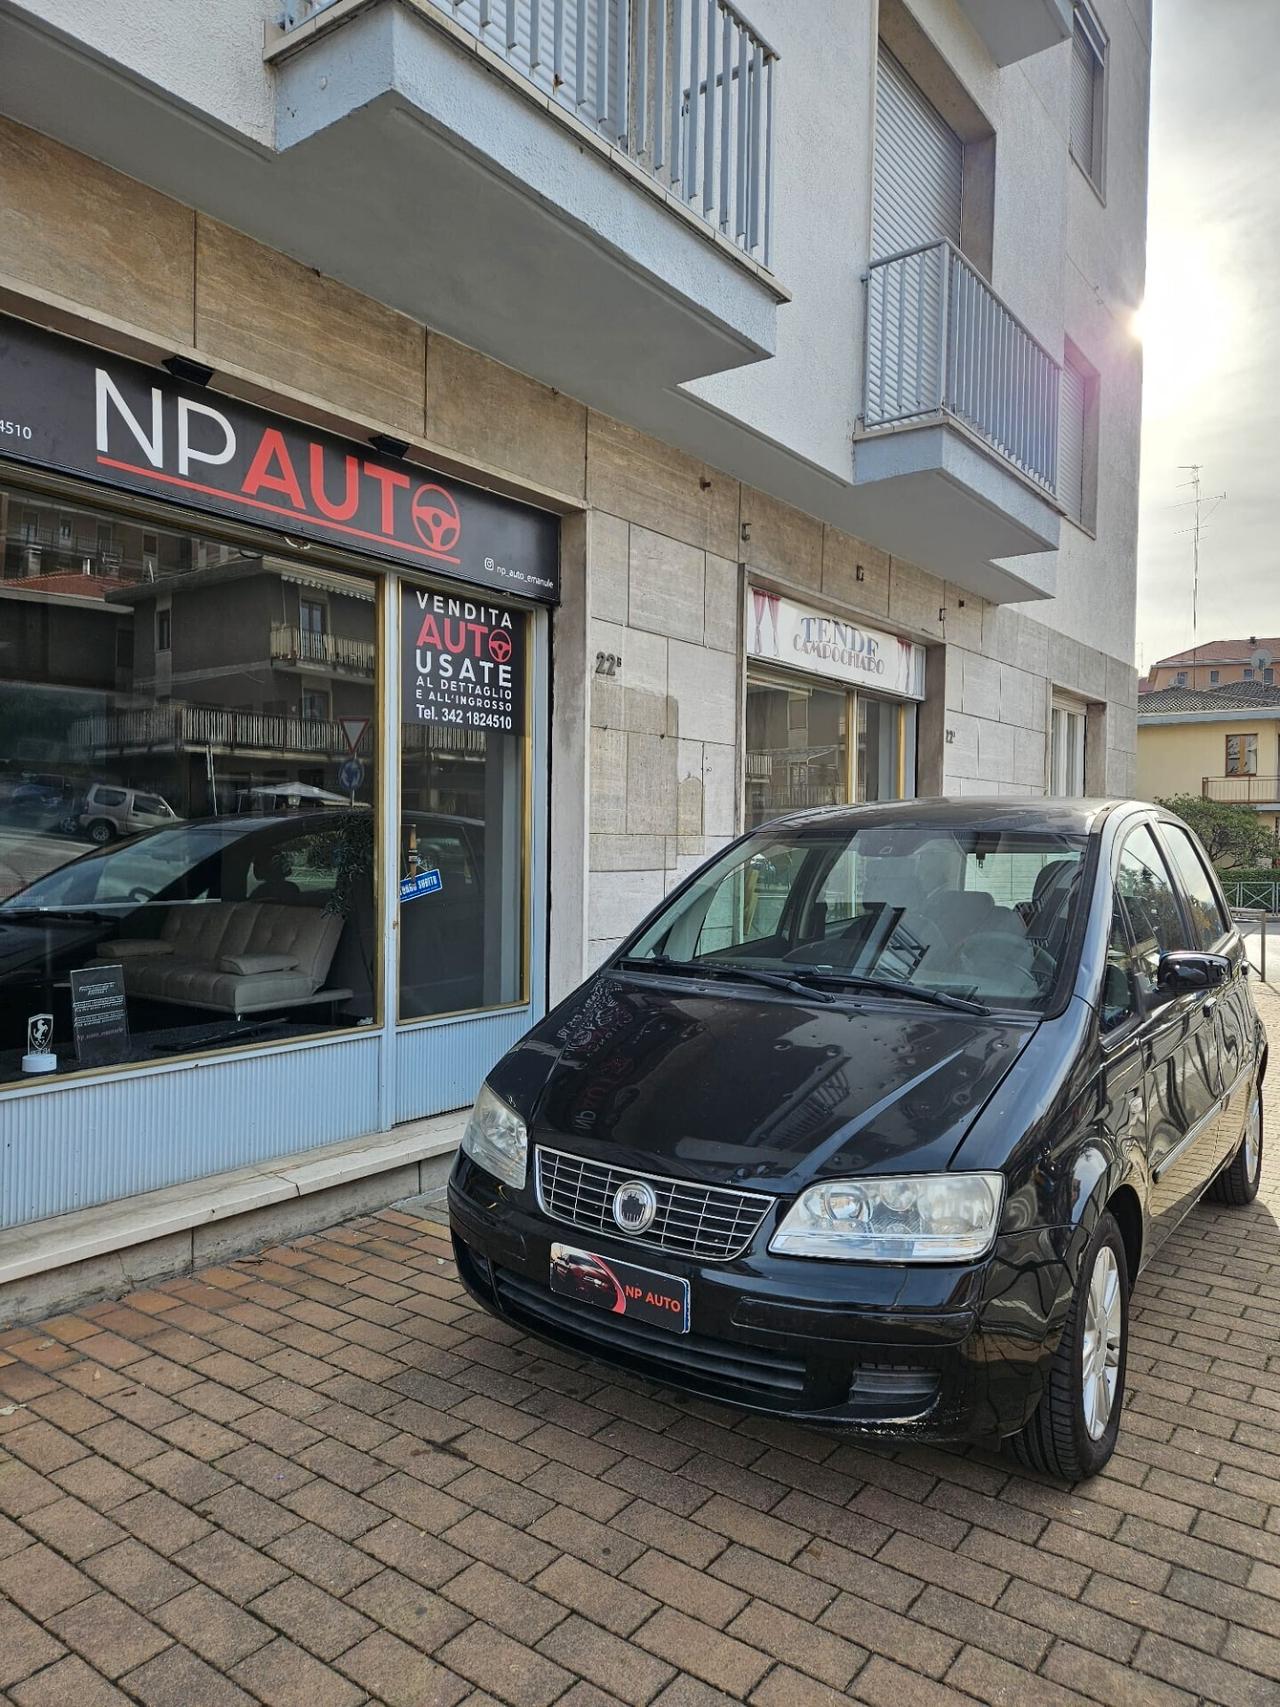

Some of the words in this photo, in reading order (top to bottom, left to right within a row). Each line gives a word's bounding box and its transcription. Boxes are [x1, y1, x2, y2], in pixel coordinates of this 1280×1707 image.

[95, 368, 236, 476] NP
[416, 591, 513, 629] VENDITA
[793, 634, 885, 674] CAMPOCHIARO
[801, 617, 879, 657] TENDE
[416, 649, 512, 687] USATE
[416, 676, 434, 688] AL
[441, 679, 512, 700] DETTAGLIO
[416, 689, 422, 699] E
[429, 691, 512, 712] ALL'INGROSSO
[416, 704, 438, 721] Tel.
[442, 708, 463, 723] 342
[467, 711, 512, 730] 1824510
[625, 1285, 642, 1299] NP
[646, 1292, 681, 1312] AUTO
